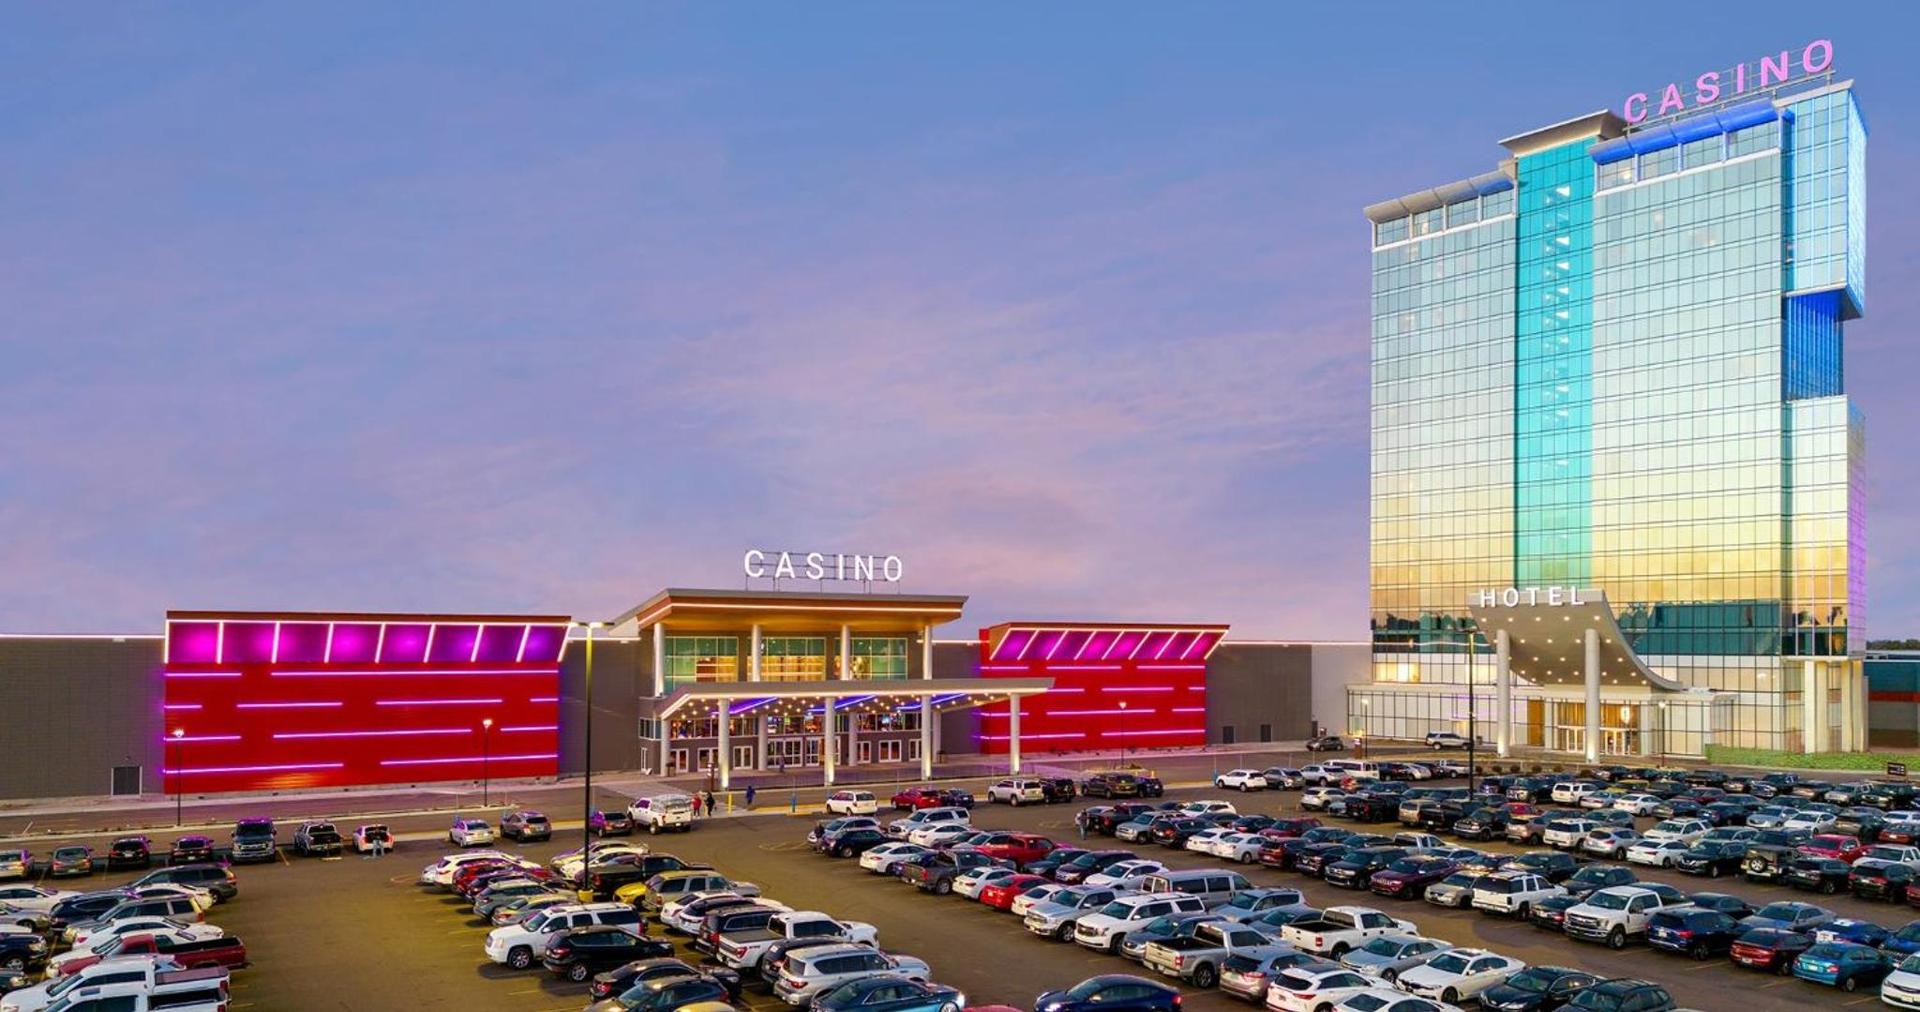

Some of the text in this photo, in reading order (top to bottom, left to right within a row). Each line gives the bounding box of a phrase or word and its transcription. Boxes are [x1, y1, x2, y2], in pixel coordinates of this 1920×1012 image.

[1624, 39, 1834, 123] CASINO
[744, 549, 903, 582] CASINO
[1479, 586, 1586, 608] HOTEL
